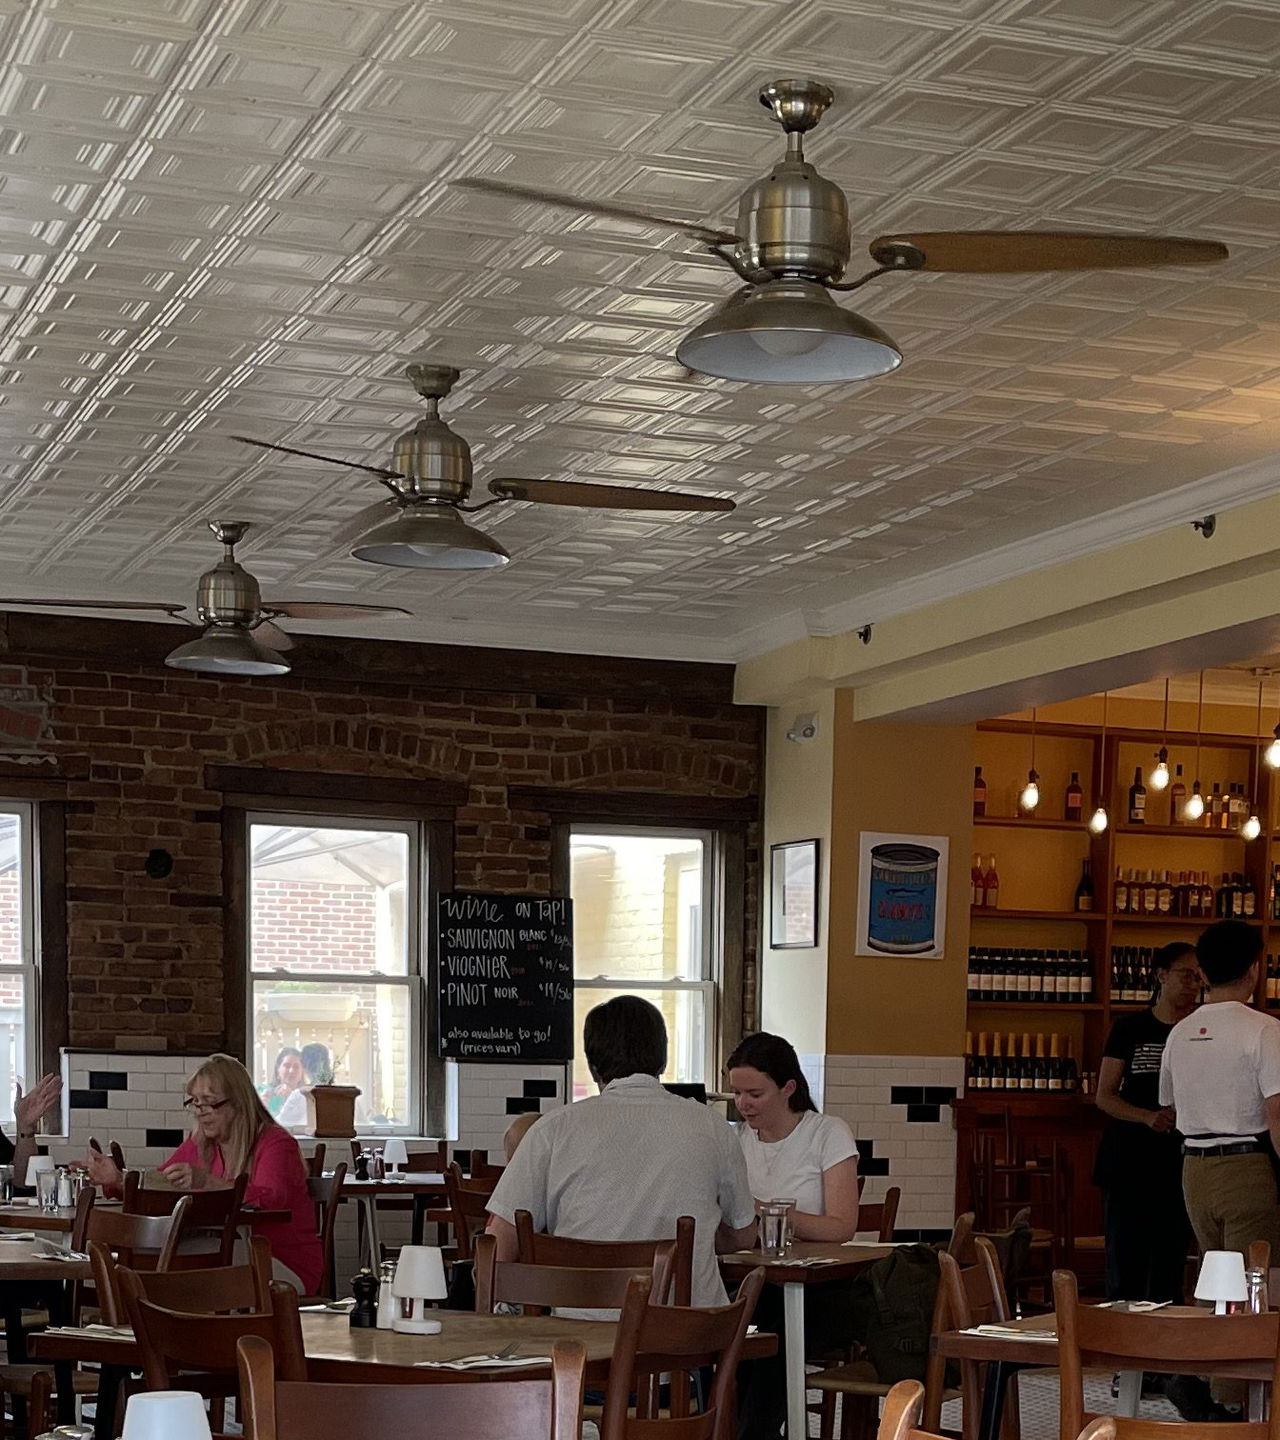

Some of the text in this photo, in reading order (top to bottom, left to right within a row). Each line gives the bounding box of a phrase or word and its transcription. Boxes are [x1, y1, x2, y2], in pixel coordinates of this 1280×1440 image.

[515, 902, 531, 918] ON
[447, 928, 515, 950] SAUVIGNON
[519, 930, 548, 942] BLANC
[448, 1025, 552, 1043] also available to go!
